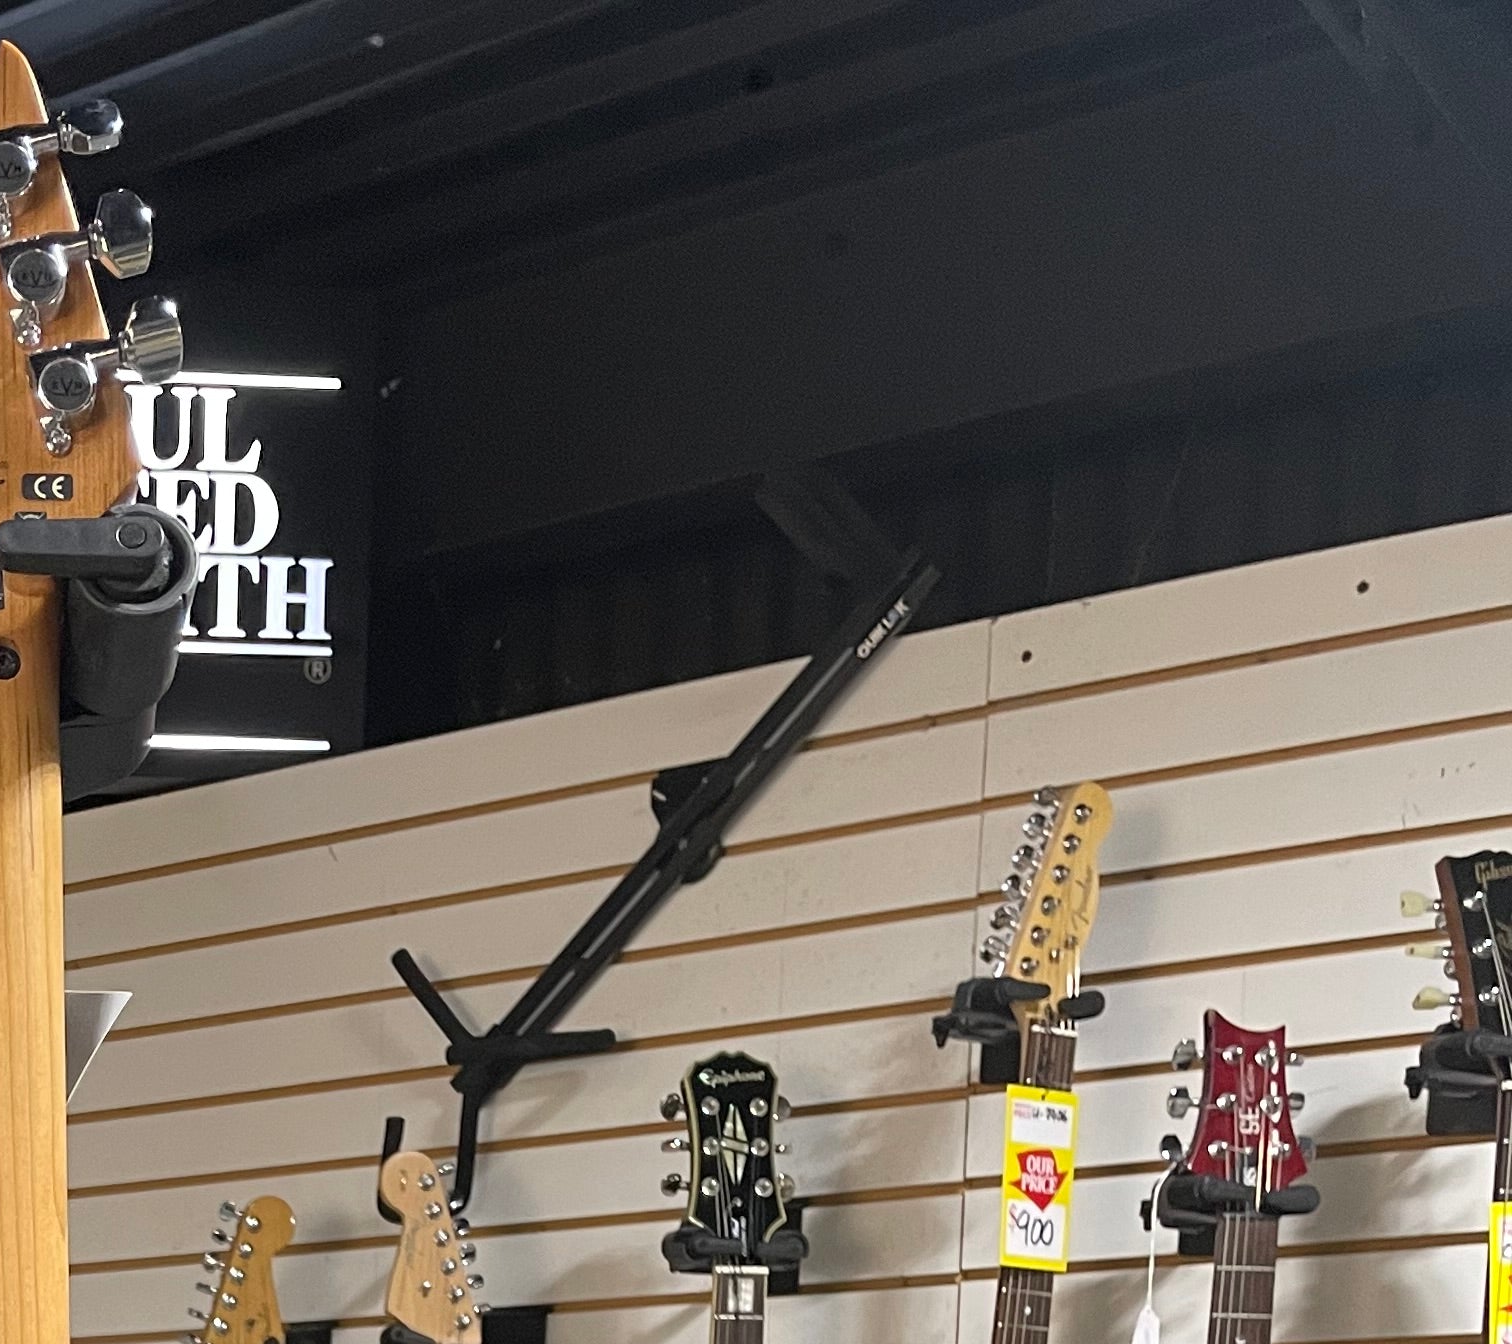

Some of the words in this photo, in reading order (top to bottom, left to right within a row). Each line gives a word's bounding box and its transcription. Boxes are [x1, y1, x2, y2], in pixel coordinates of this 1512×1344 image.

[123, 384, 262, 472] UL
[32, 474, 66, 500] CE
[136, 469, 280, 555] ED
[1025, 1155, 1056, 1177] OUR
[1020, 1173, 1058, 1195] PRICE
